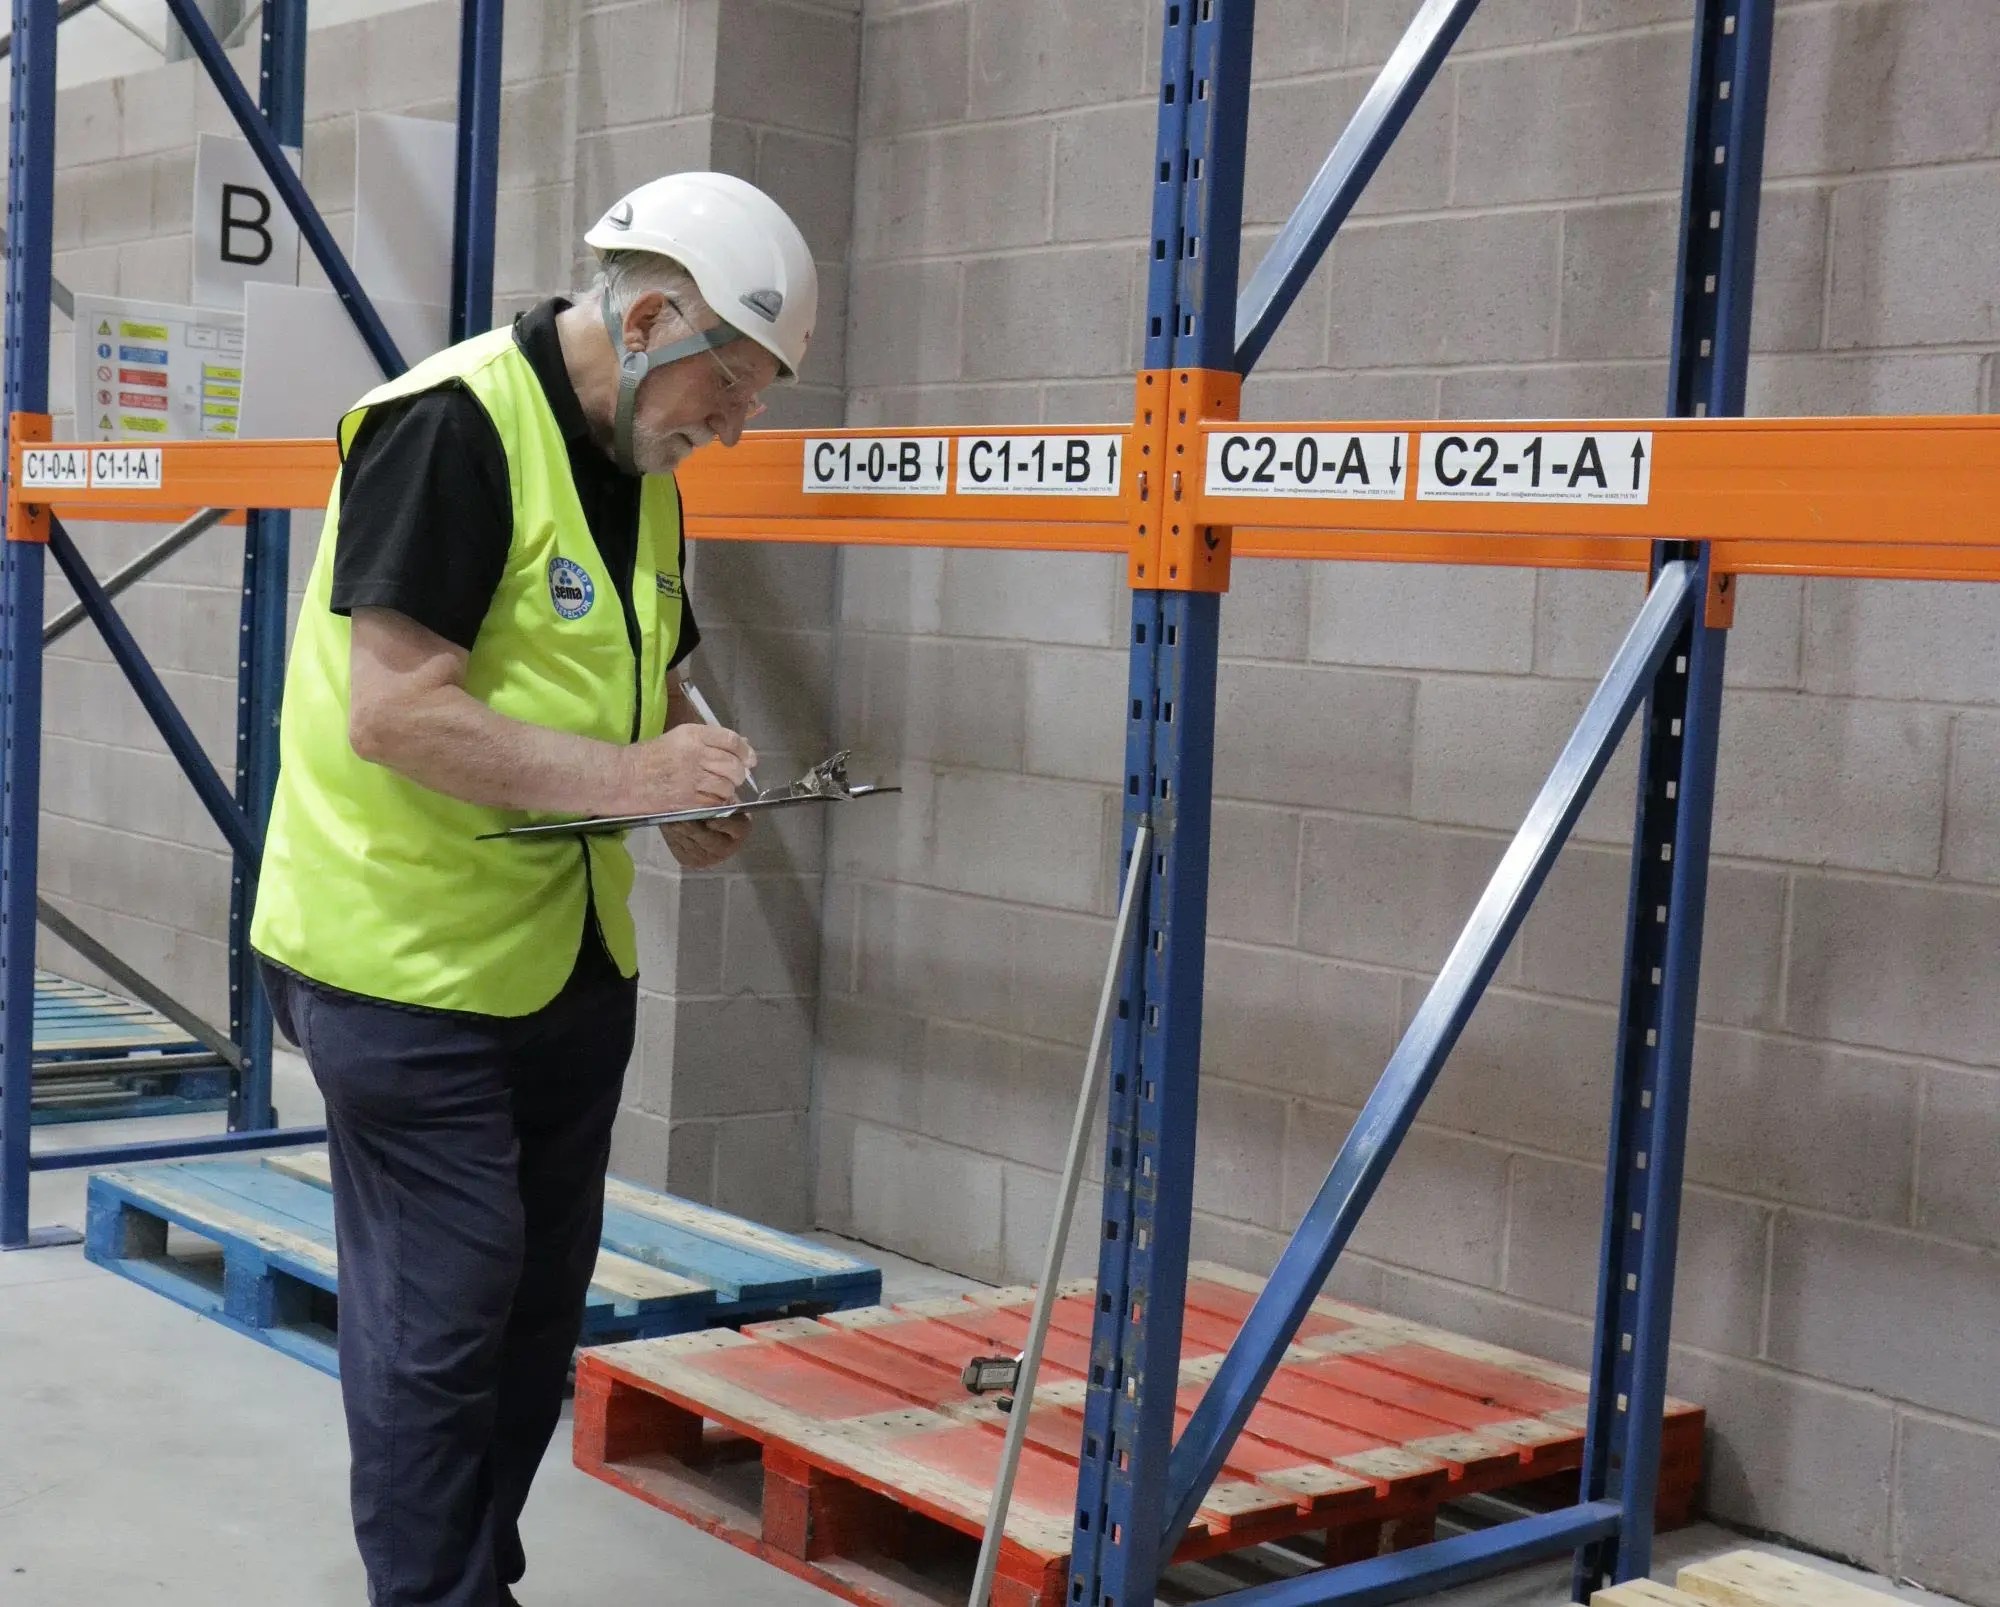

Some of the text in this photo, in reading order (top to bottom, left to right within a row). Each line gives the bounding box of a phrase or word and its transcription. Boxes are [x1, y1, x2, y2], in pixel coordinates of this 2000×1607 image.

[220, 182, 273, 266] B
[27, 452, 77, 479] C1-0-A
[96, 451, 149, 479] C1-1-A
[814, 441, 921, 482] C1-0-B
[969, 439, 1090, 483] C1-1-B
[1220, 435, 1371, 485] C2-0-A
[1434, 436, 1608, 488] C2-1-A
[554, 585, 583, 600] sema
